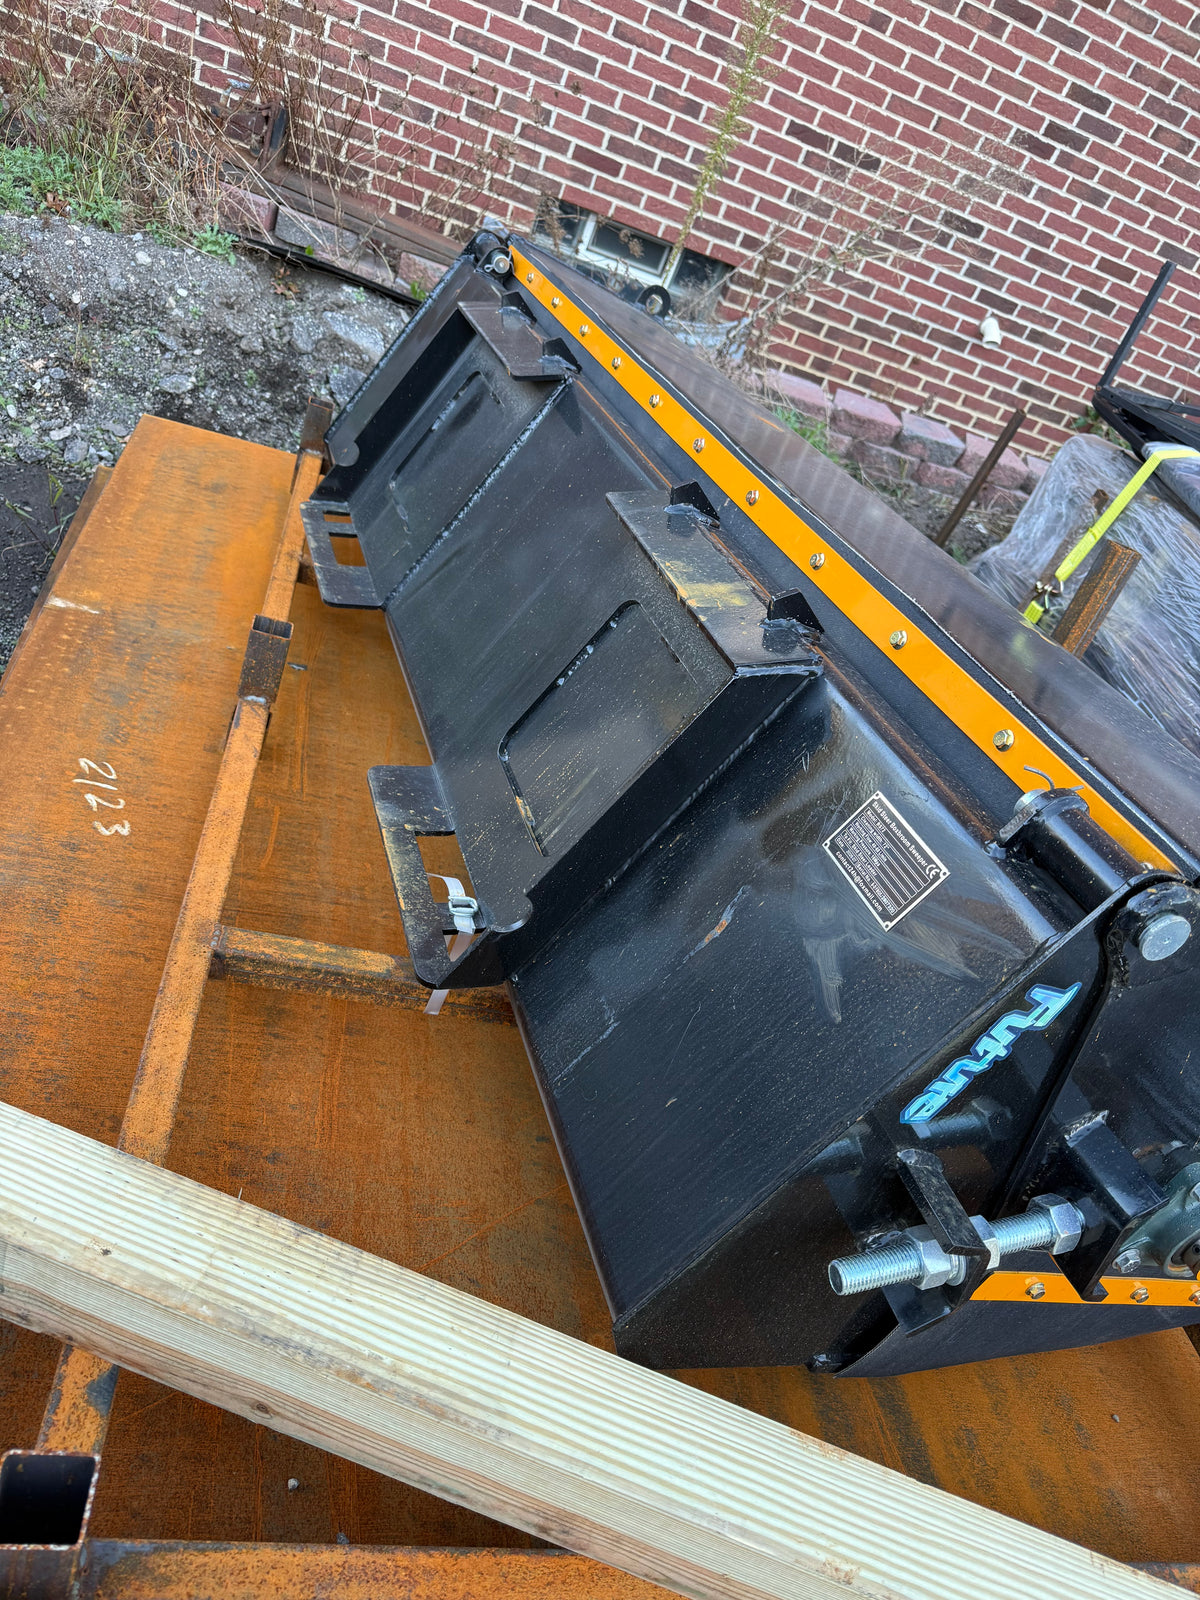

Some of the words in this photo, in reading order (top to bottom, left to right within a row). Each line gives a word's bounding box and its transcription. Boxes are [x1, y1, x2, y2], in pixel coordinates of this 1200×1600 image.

[72, 757, 131, 836] 2123
[872, 801, 883, 813] Skid
[880, 811, 892, 824] Steer
[890, 822, 910, 847] Boxbroom
[909, 845, 927, 866] Sweeper
[836, 852, 882, 912] contact24h@foxmail.com
[926, 864, 940, 879] CE
